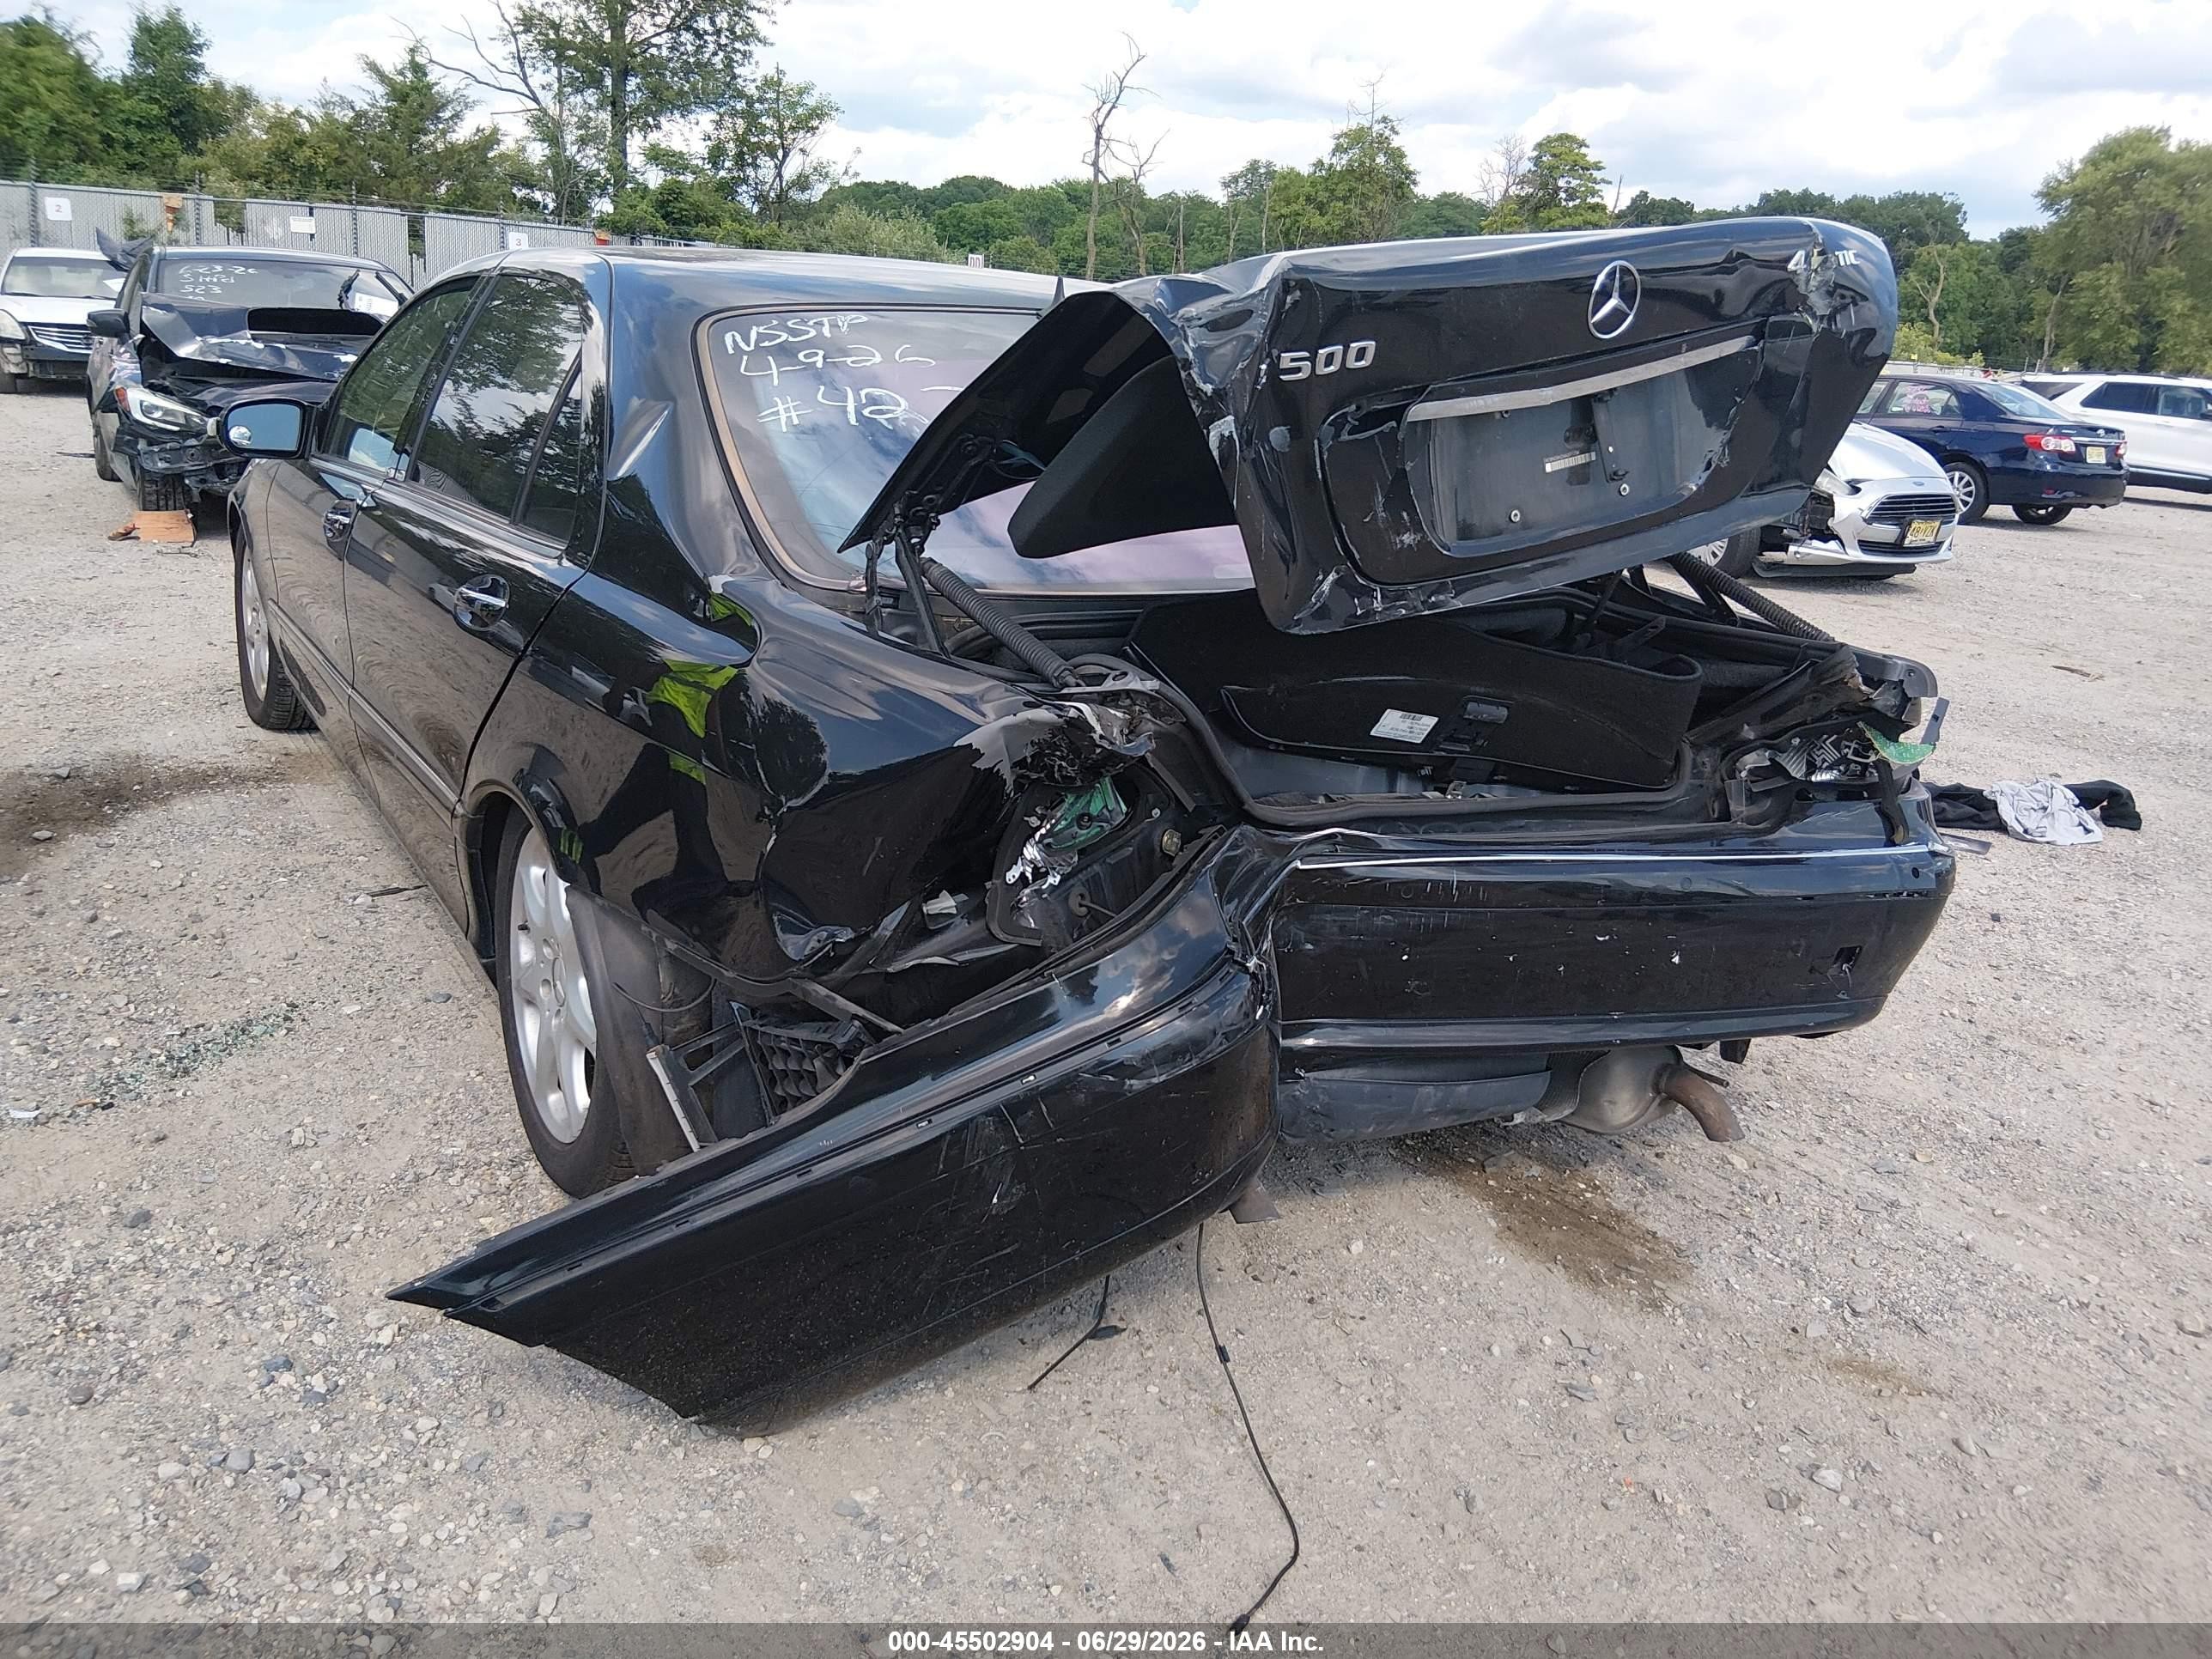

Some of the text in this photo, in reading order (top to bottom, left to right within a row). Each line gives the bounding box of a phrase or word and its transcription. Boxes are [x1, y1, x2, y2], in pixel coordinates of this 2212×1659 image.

[55, 204, 63, 213] 2
[515, 238, 522, 246] 3
[179, 284, 222, 294] 523
[1279, 341, 1376, 381] 500
